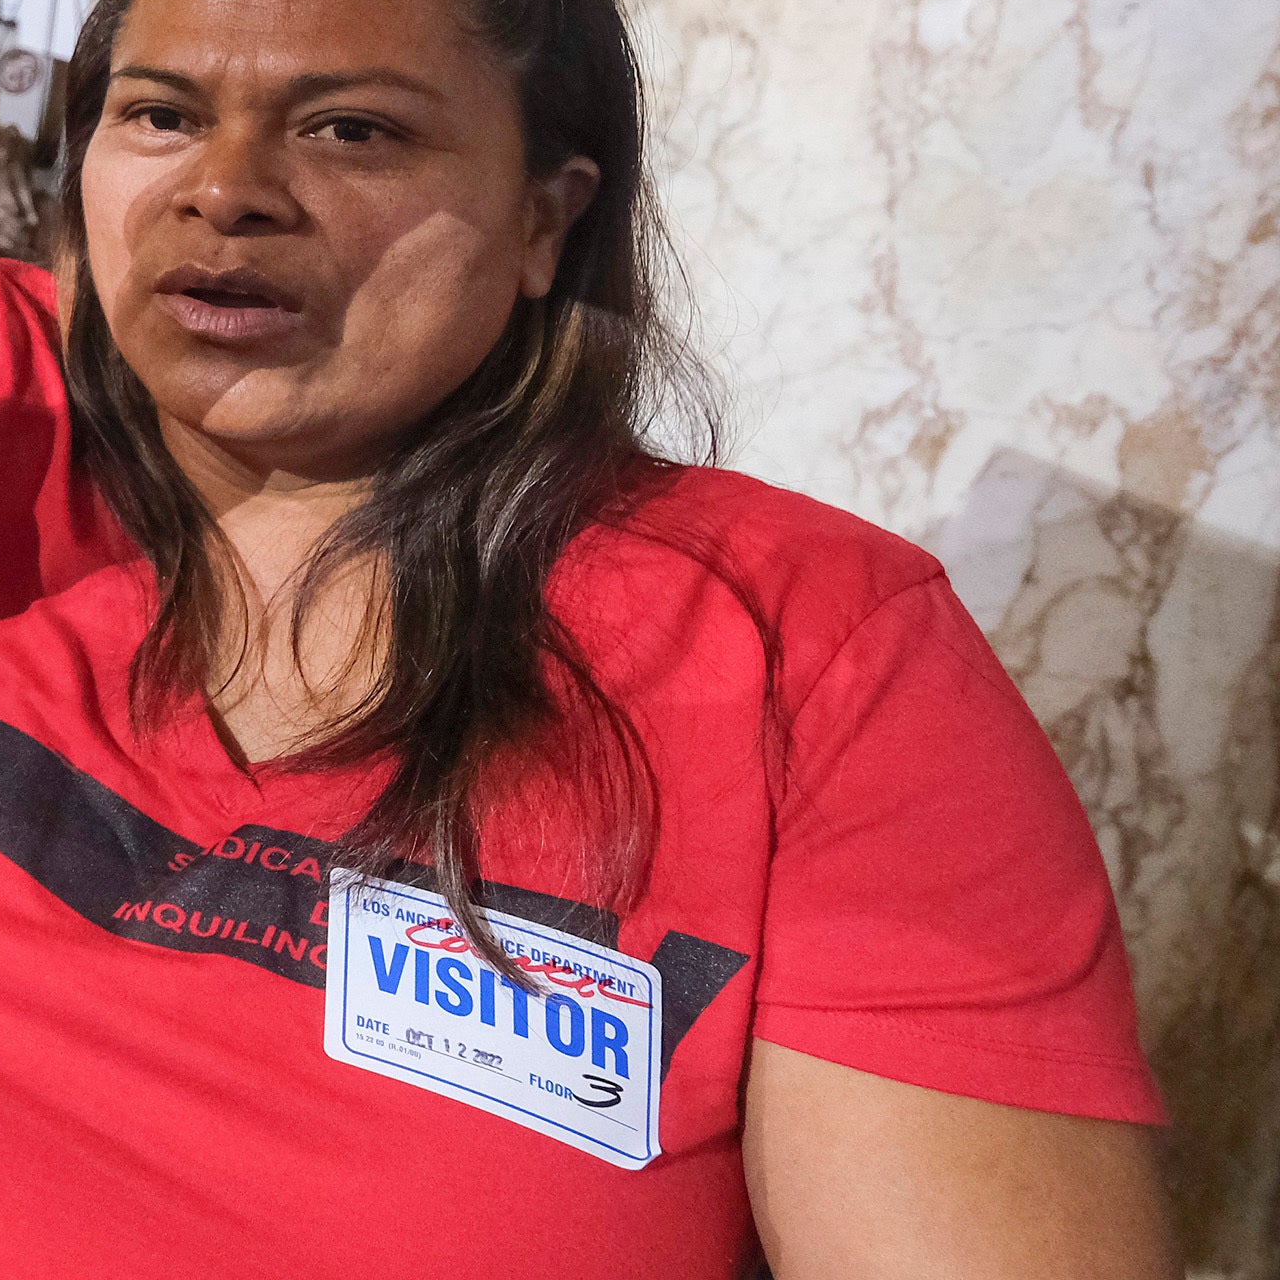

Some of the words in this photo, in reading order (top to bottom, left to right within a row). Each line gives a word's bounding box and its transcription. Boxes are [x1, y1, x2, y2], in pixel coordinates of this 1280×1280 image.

[363, 898, 390, 917] LOS
[395, 908, 464, 939] ANGELES
[530, 947, 637, 998] DEPARTMENT
[356, 1015, 391, 1036] DATE
[405, 1027, 434, 1051] OCT
[367, 934, 631, 1080] VISITOR
[529, 1073, 574, 1102] FLOOR
[573, 1073, 624, 1108] 3
